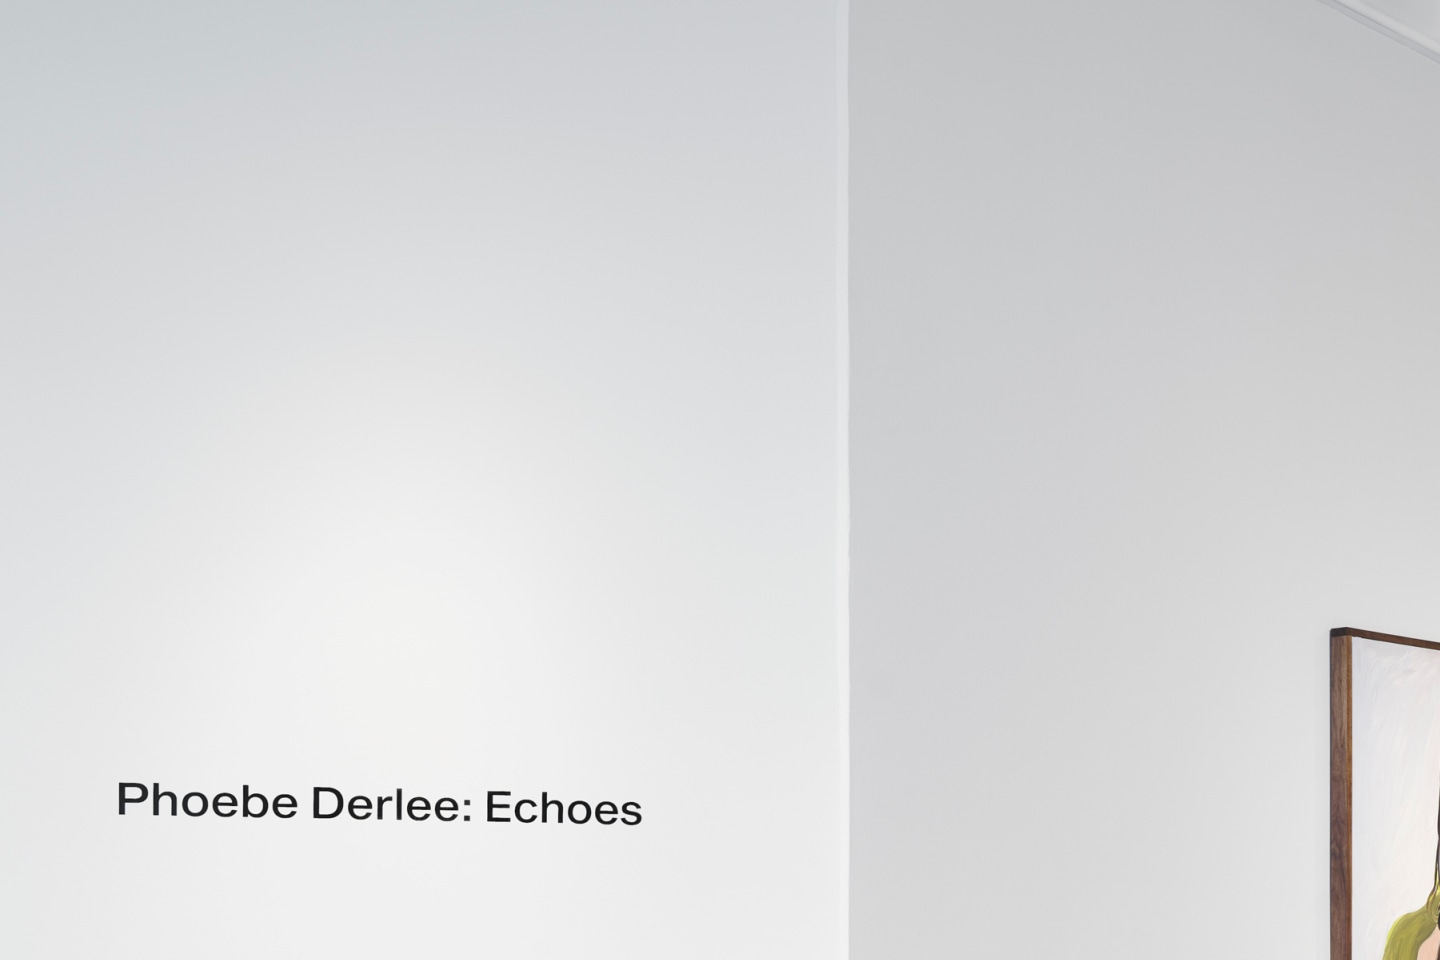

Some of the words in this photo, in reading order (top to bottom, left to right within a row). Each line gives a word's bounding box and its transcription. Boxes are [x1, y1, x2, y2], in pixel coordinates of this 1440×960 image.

[118, 782, 298, 819] Phoebe
[312, 786, 471, 822] Derlee:
[486, 790, 643, 826] Echoes
